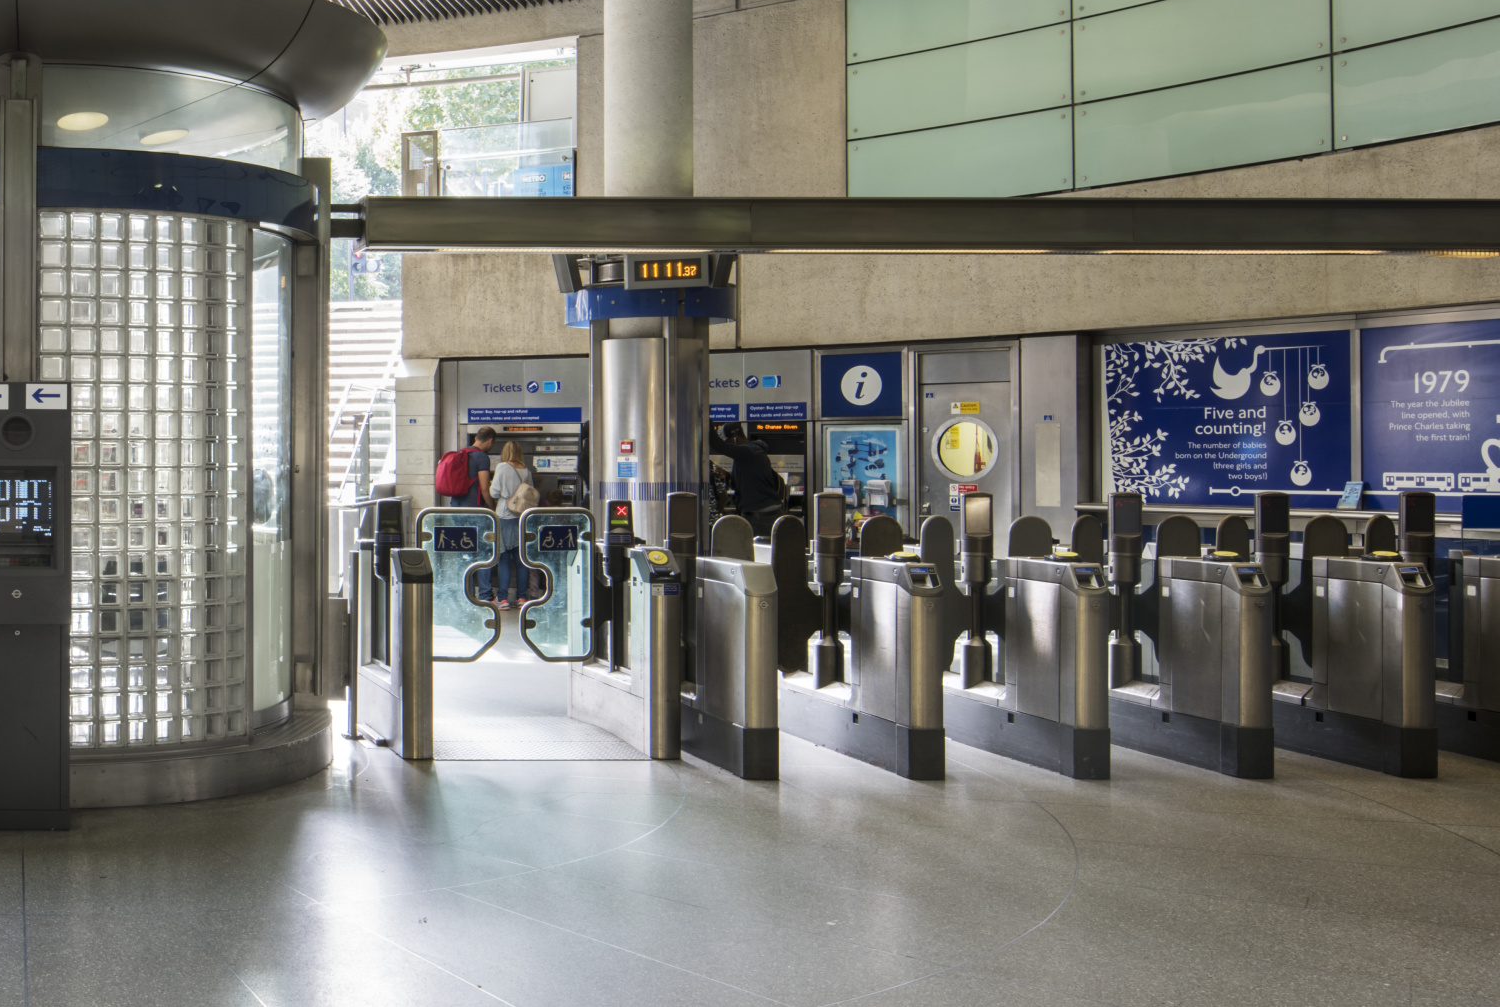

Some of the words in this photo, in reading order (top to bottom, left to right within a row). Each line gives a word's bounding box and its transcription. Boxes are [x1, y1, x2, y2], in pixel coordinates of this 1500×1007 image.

[709, 378, 740, 388] ckets
[1414, 369, 1470, 394] 1979
[482, 383, 522, 393] Tickets
[1391, 400, 1405, 408] The
[1407, 401, 1423, 409] year
[1441, 399, 1470, 407] Jubilee
[1204, 407, 1234, 419] Five
[1238, 406, 1266, 419] and
[1401, 411, 1415, 419] line
[1452, 410, 1470, 418] with
[1195, 421, 1266, 437] counting!
[1414, 422, 1444, 430] Charles
[1446, 422, 1471, 431] taking
[1448, 433, 1470, 441] train!
[1218, 452, 1267, 460] Underground
[1213, 462, 1234, 470] (three
[1236, 462, 1251, 471] girls
[1244, 472, 1267, 481] boys!)
